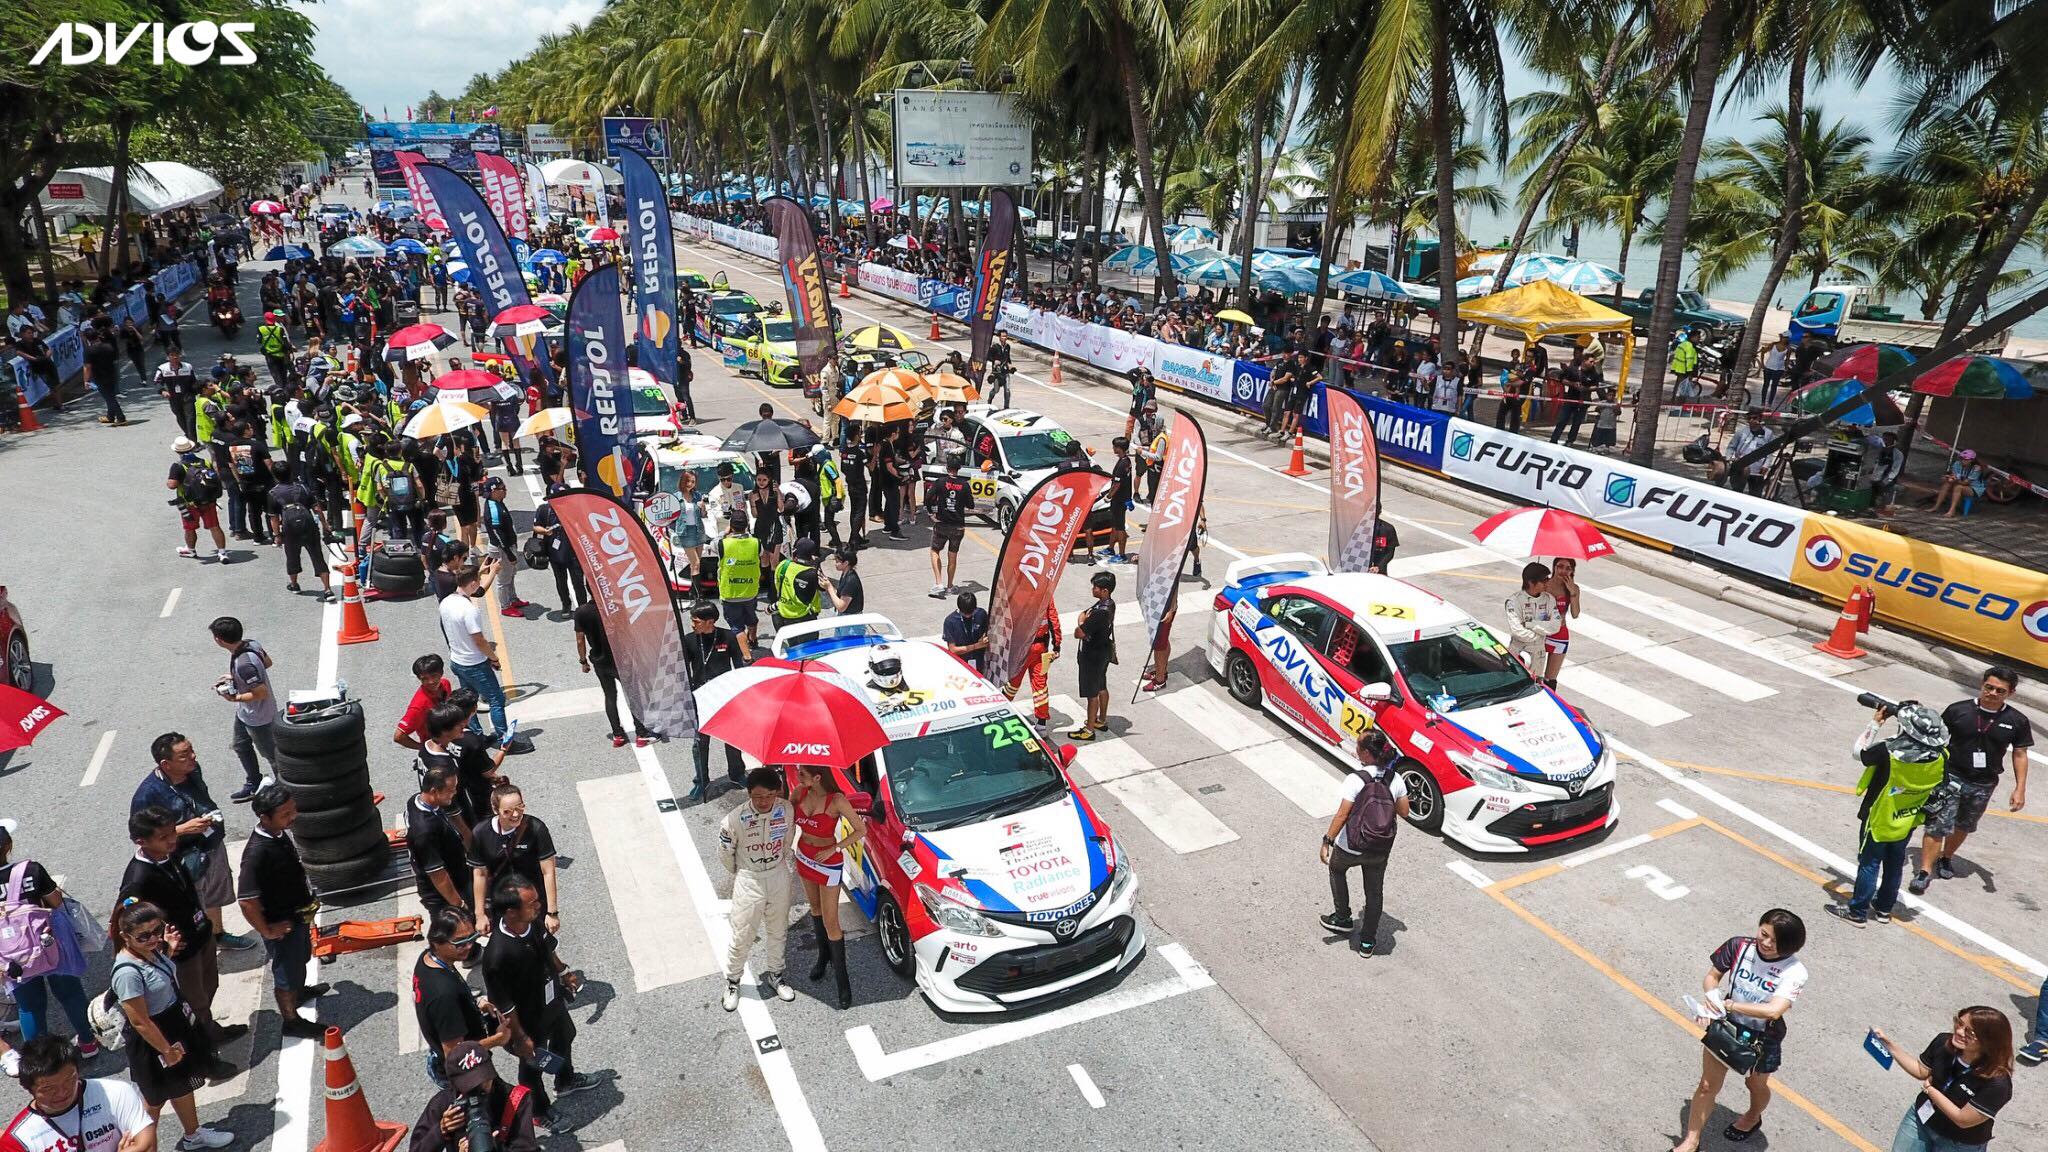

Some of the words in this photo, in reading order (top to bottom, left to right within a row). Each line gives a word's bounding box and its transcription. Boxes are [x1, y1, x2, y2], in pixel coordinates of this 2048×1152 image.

[904, 105, 967, 113] BANGSAEN
[1020, 326, 1034, 336] SERIE
[584, 326, 619, 436] REPSOL
[1161, 359, 1223, 387] BANGSAEN
[1369, 410, 1432, 455] MAHA
[972, 482, 995, 497] 96
[651, 495, 671, 513] 31
[1018, 482, 1074, 590] ADVICS
[1052, 540, 1066, 566] Safety
[1063, 506, 1082, 541] Evolution
[1844, 553, 2019, 621] SUSCO
[1374, 605, 1406, 619] 22
[880, 704, 929, 726] ANGSAEN
[931, 699, 957, 713] 200
[1343, 707, 1366, 735] 22
[888, 731, 912, 739] OYOTA
[984, 718, 1031, 749] 25
[781, 743, 831, 756] ADVICS
[1893, 805, 1922, 820] MED
[1007, 856, 1073, 880] TOYOTA
[1013, 868, 1081, 894] Radiance
[1624, 865, 1691, 900] 2
[953, 941, 978, 952] arto
[85, 1122, 115, 1142] Osaka
